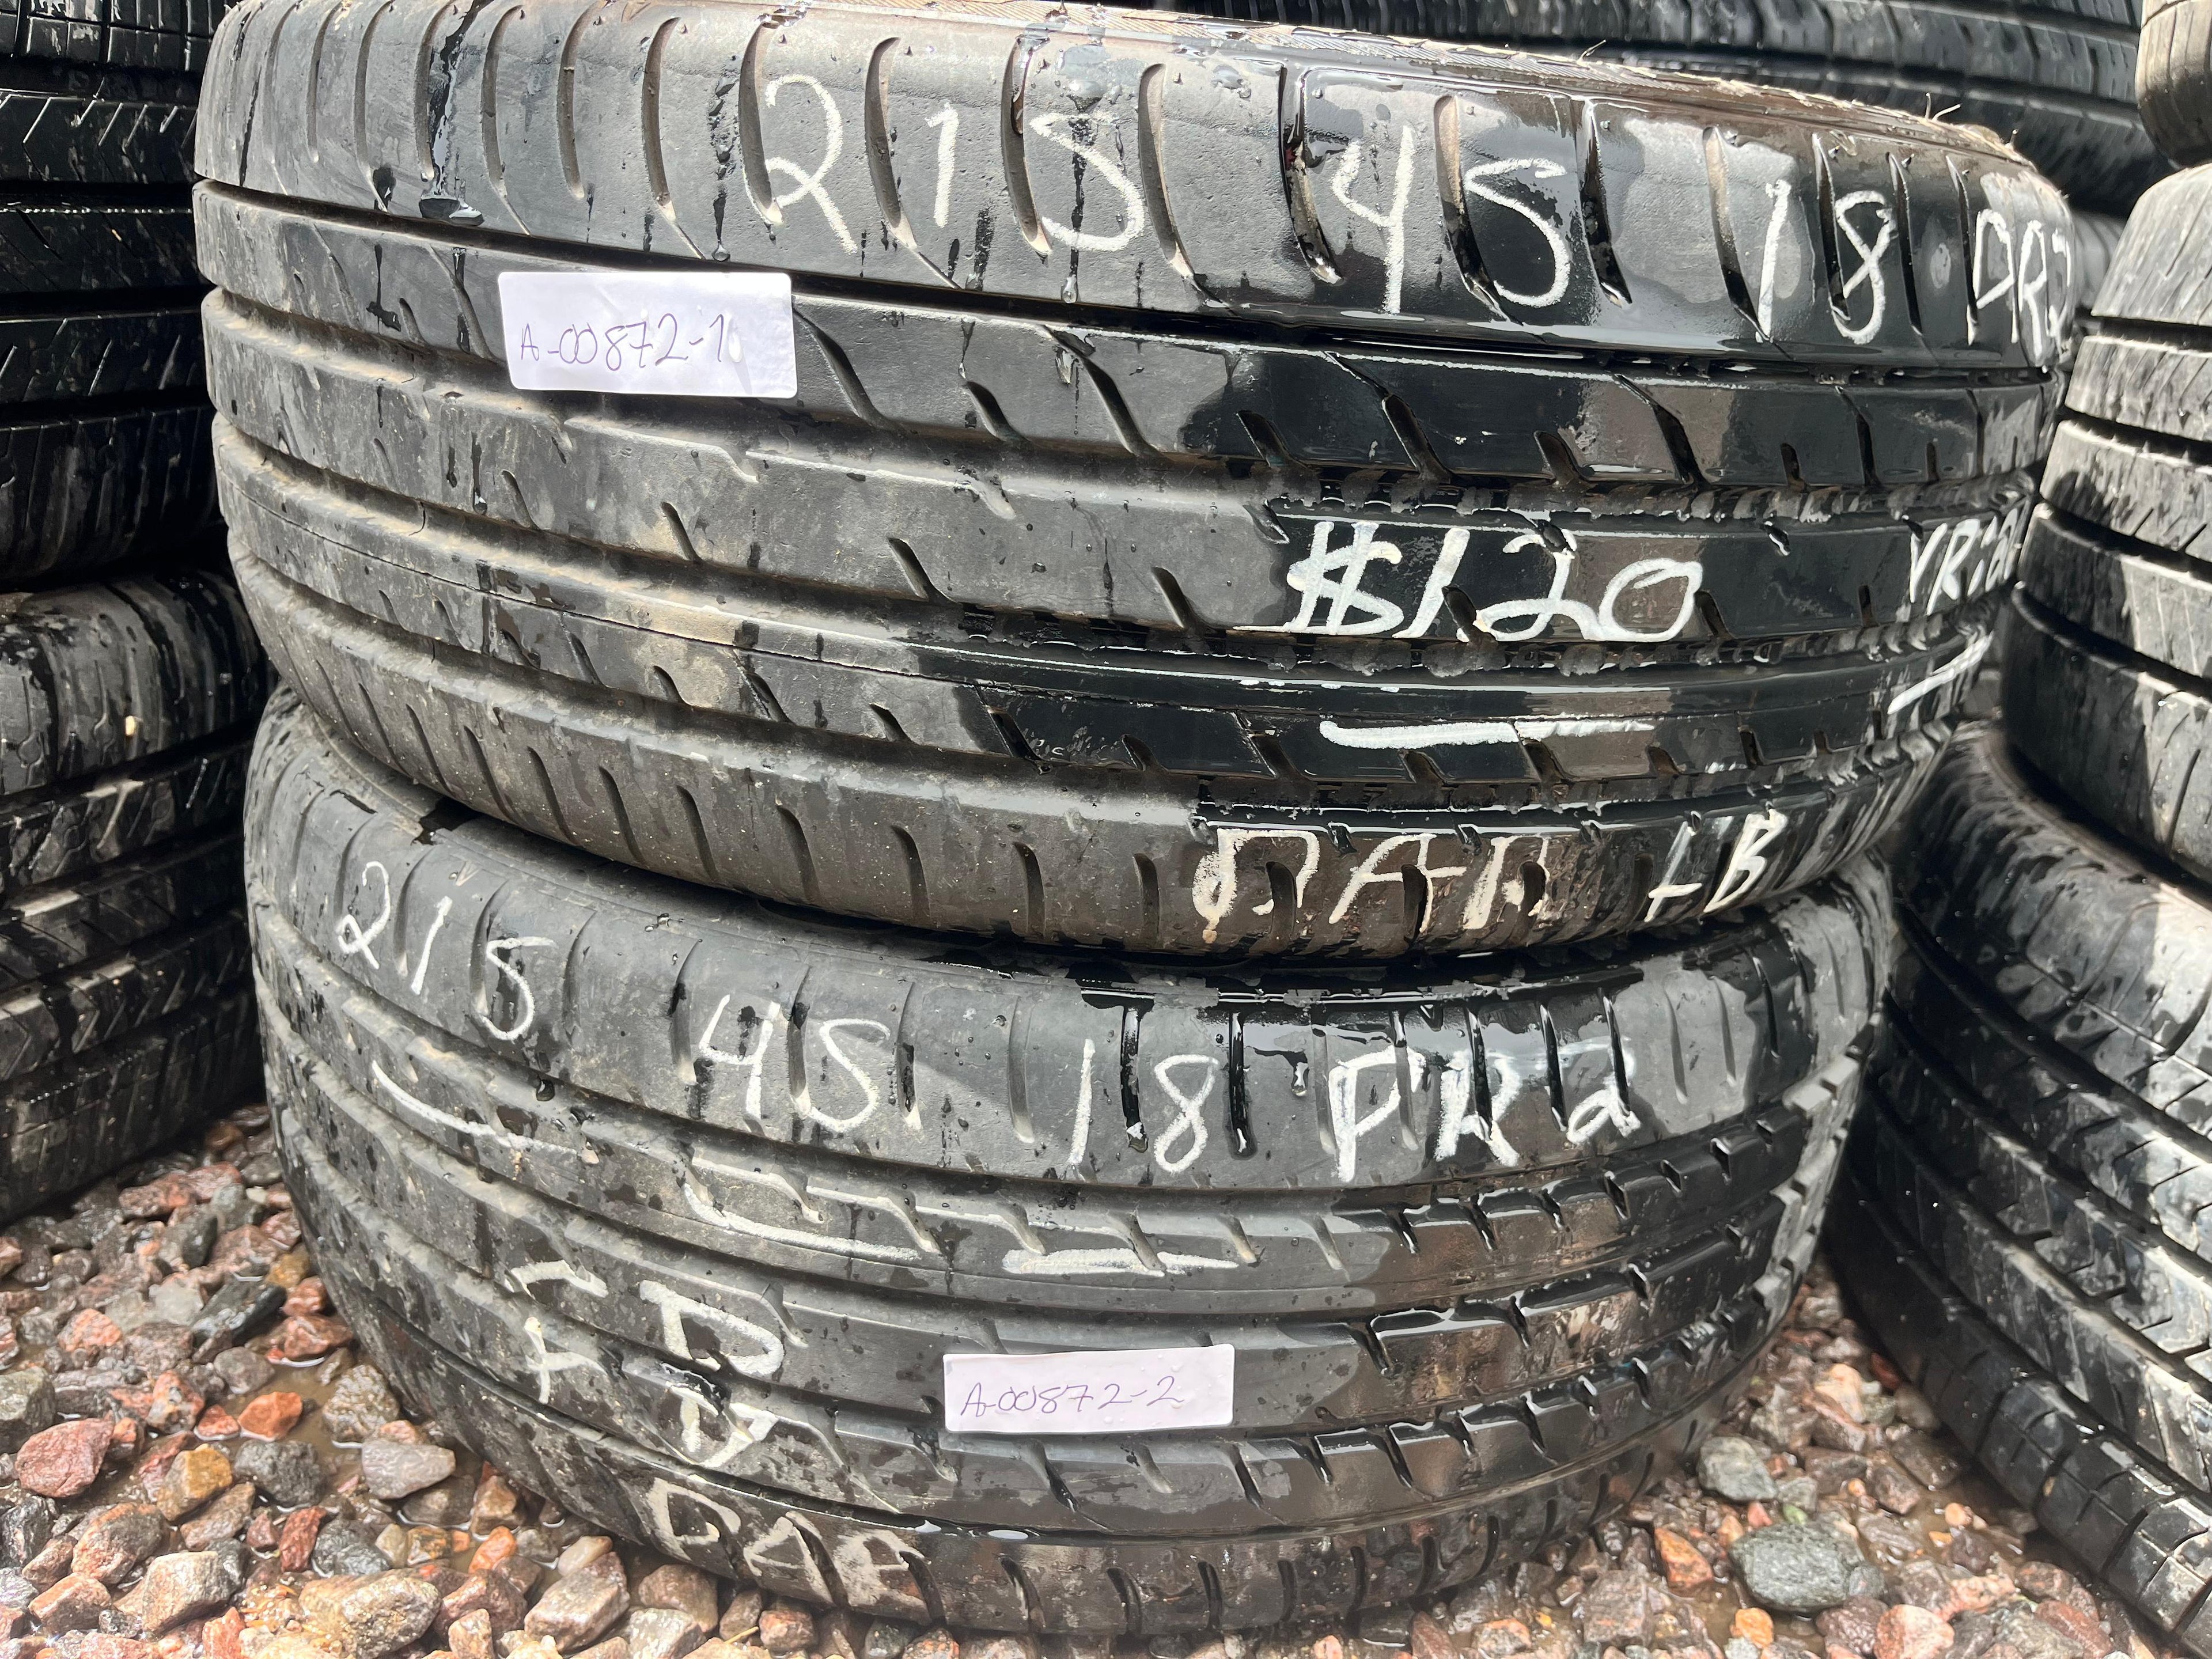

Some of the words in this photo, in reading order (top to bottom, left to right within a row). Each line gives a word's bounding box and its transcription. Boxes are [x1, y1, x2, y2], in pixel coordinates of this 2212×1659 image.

[743, 73, 1145, 255] 215
[1331, 123, 1571, 315] 45
[1755, 179, 1897, 344] 18
[520, 313, 725, 372] A-00872-1
[1286, 520, 1703, 642] $120
[336, 861, 557, 1040] 215
[699, 994, 891, 1133] 45
[1067, 1039, 1219, 1173] 18
[960, 1375, 1185, 1417] A-00872-2
